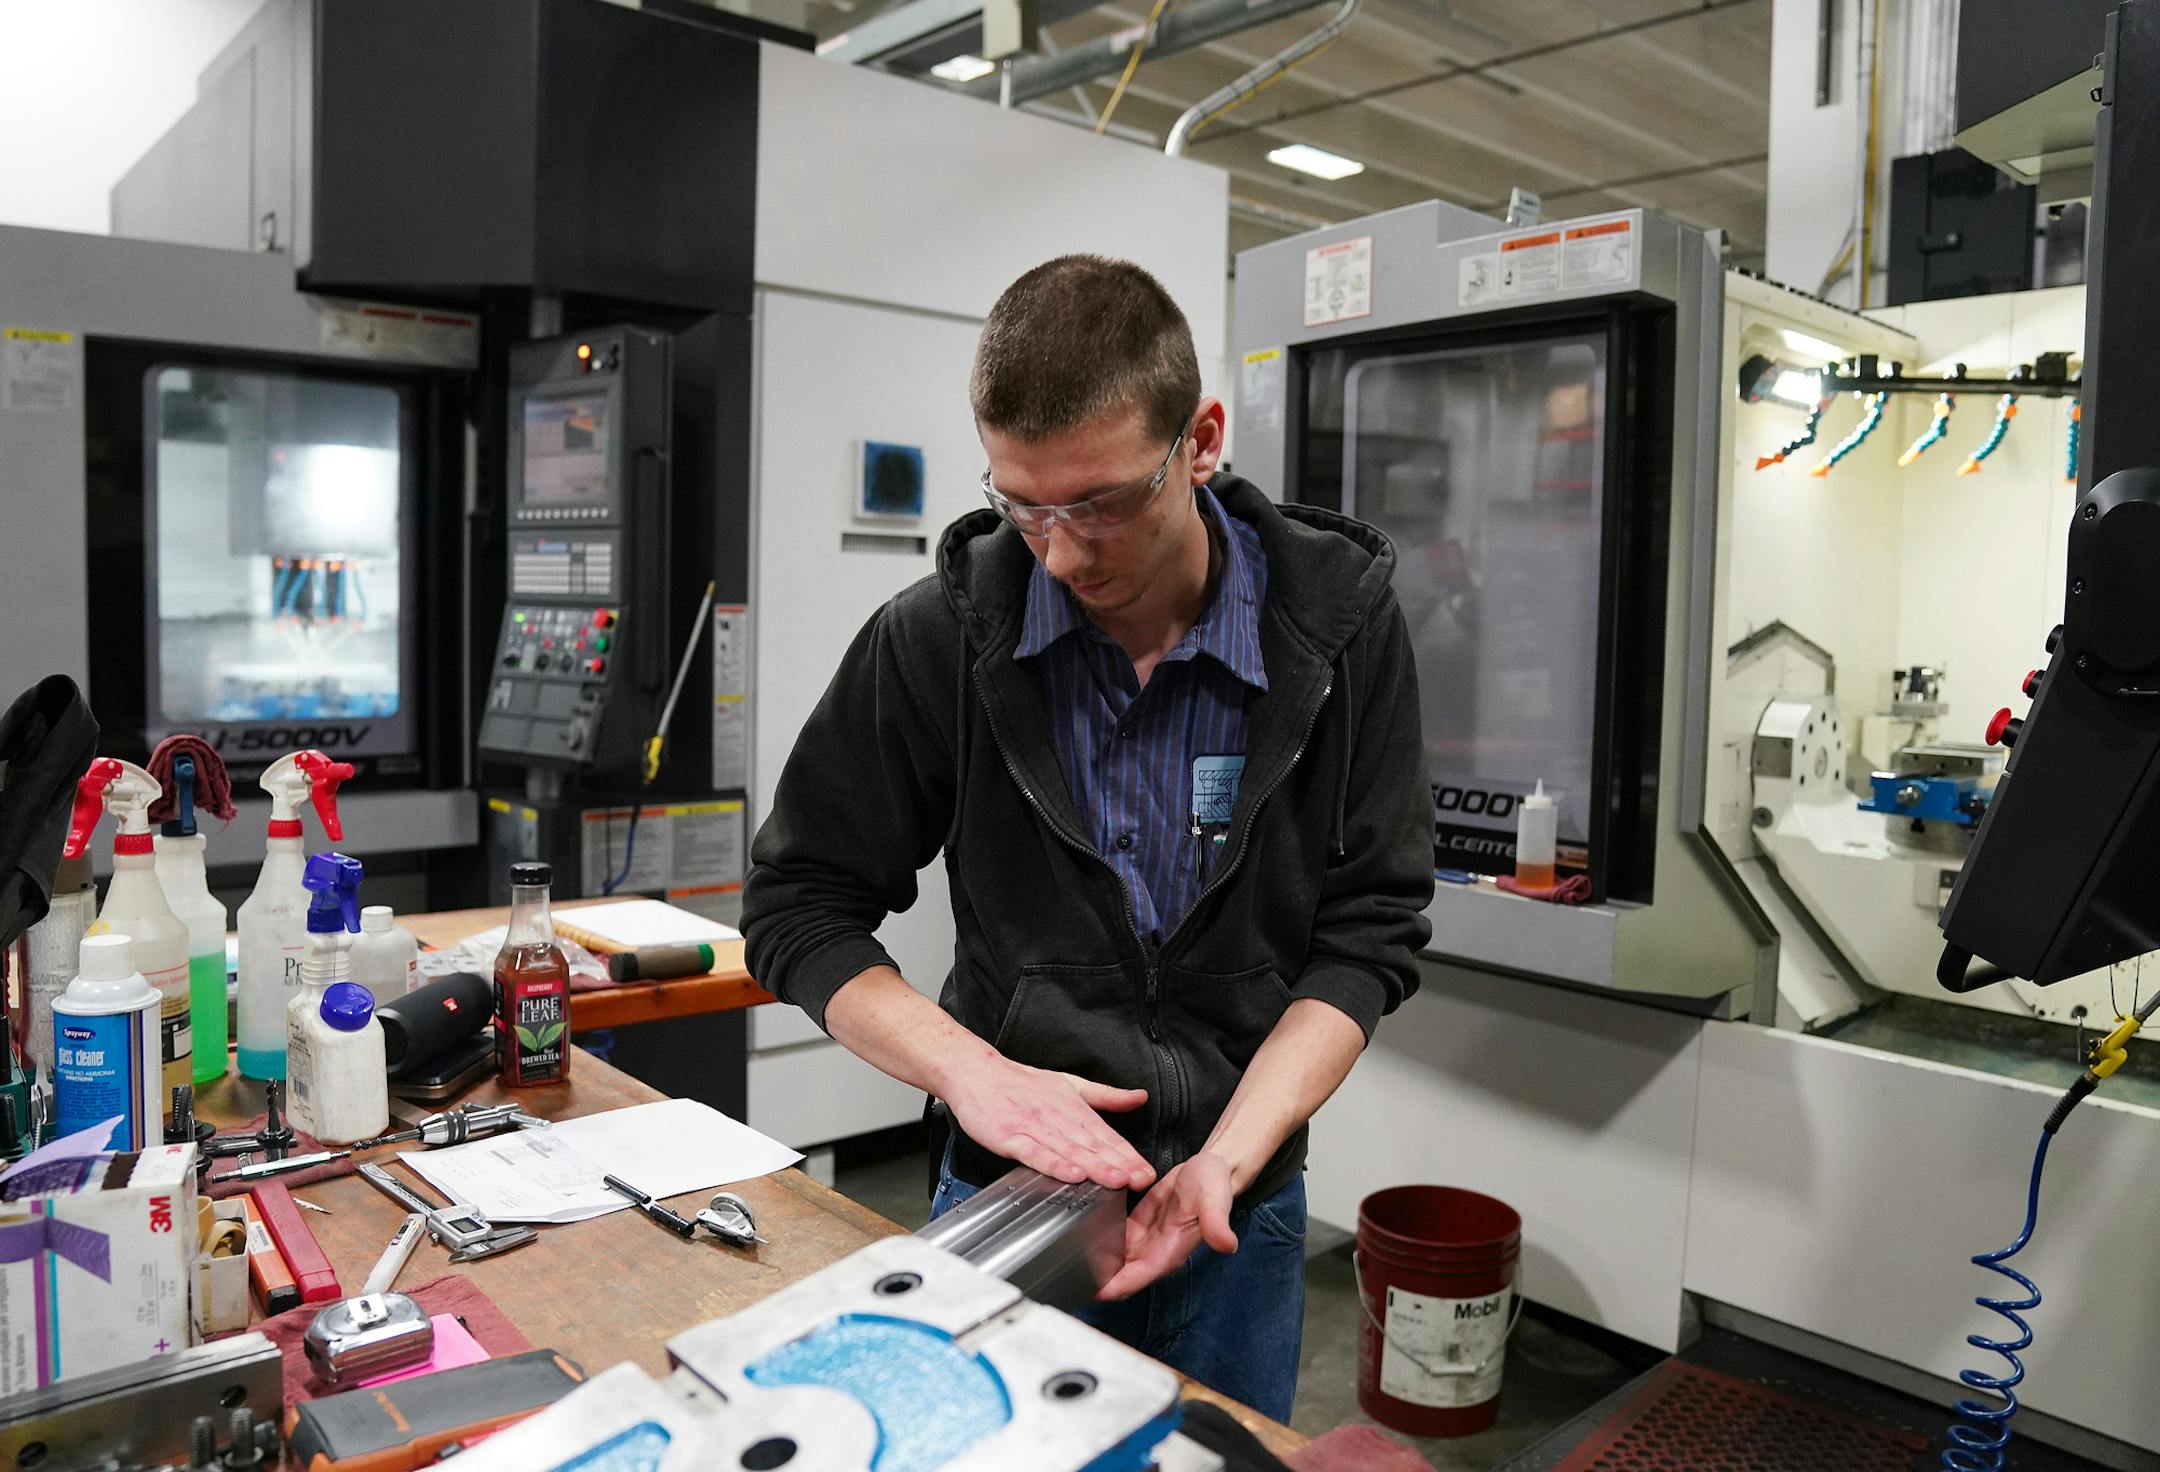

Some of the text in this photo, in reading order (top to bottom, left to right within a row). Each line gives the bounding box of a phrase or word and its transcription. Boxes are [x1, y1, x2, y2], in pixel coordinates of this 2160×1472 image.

[1450, 835, 1517, 858] CENTE
[285, 957, 303, 977] Pr
[522, 997, 559, 1012] PURE
[522, 1009, 558, 1024] LEAF
[64, 1028, 91, 1039] Sprayway
[76, 1049, 105, 1067] cleaner
[521, 1054, 547, 1065] BREWED
[548, 1052, 560, 1061] TEA
[149, 1195, 173, 1233] 3M
[1454, 1296, 1501, 1320] Mobil
